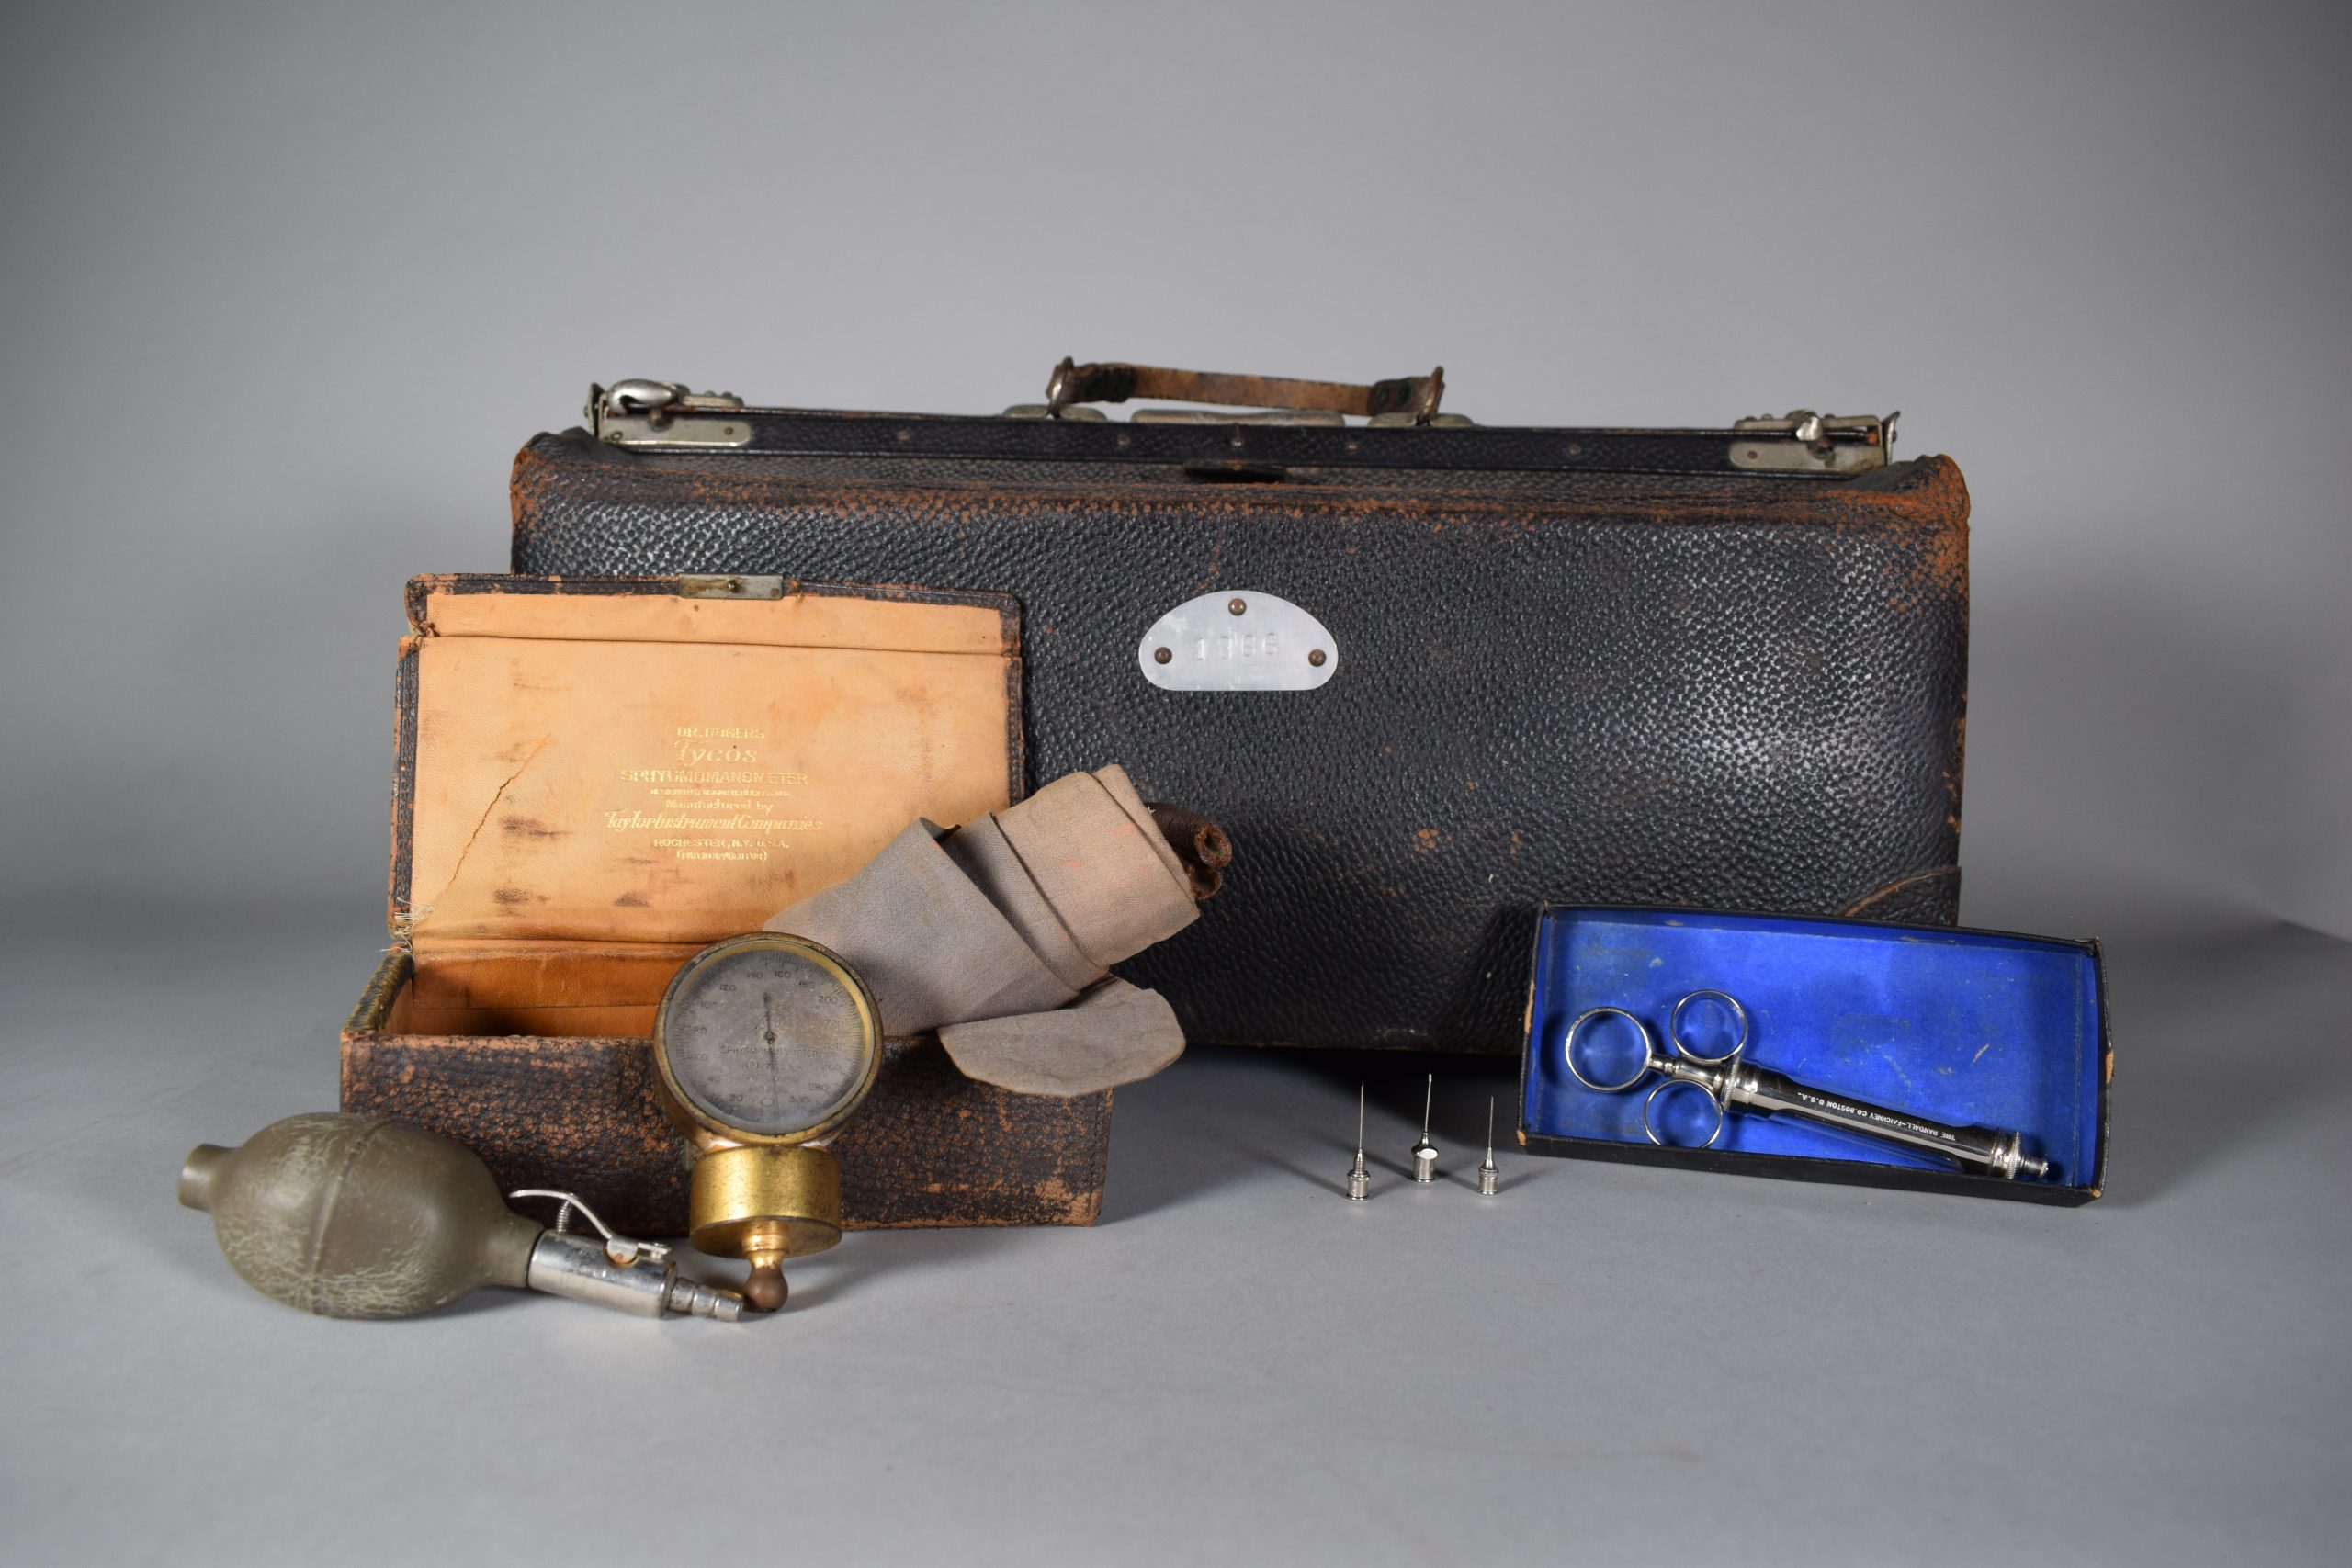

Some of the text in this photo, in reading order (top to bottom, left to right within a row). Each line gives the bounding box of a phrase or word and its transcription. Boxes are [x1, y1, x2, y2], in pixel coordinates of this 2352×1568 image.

[673, 739, 758, 767] Tycos
[756, 800, 774, 816] by
[604, 809, 651, 832] Taylor
[818, 995, 838, 1004] 200
[729, 1093, 743, 1102] 20
